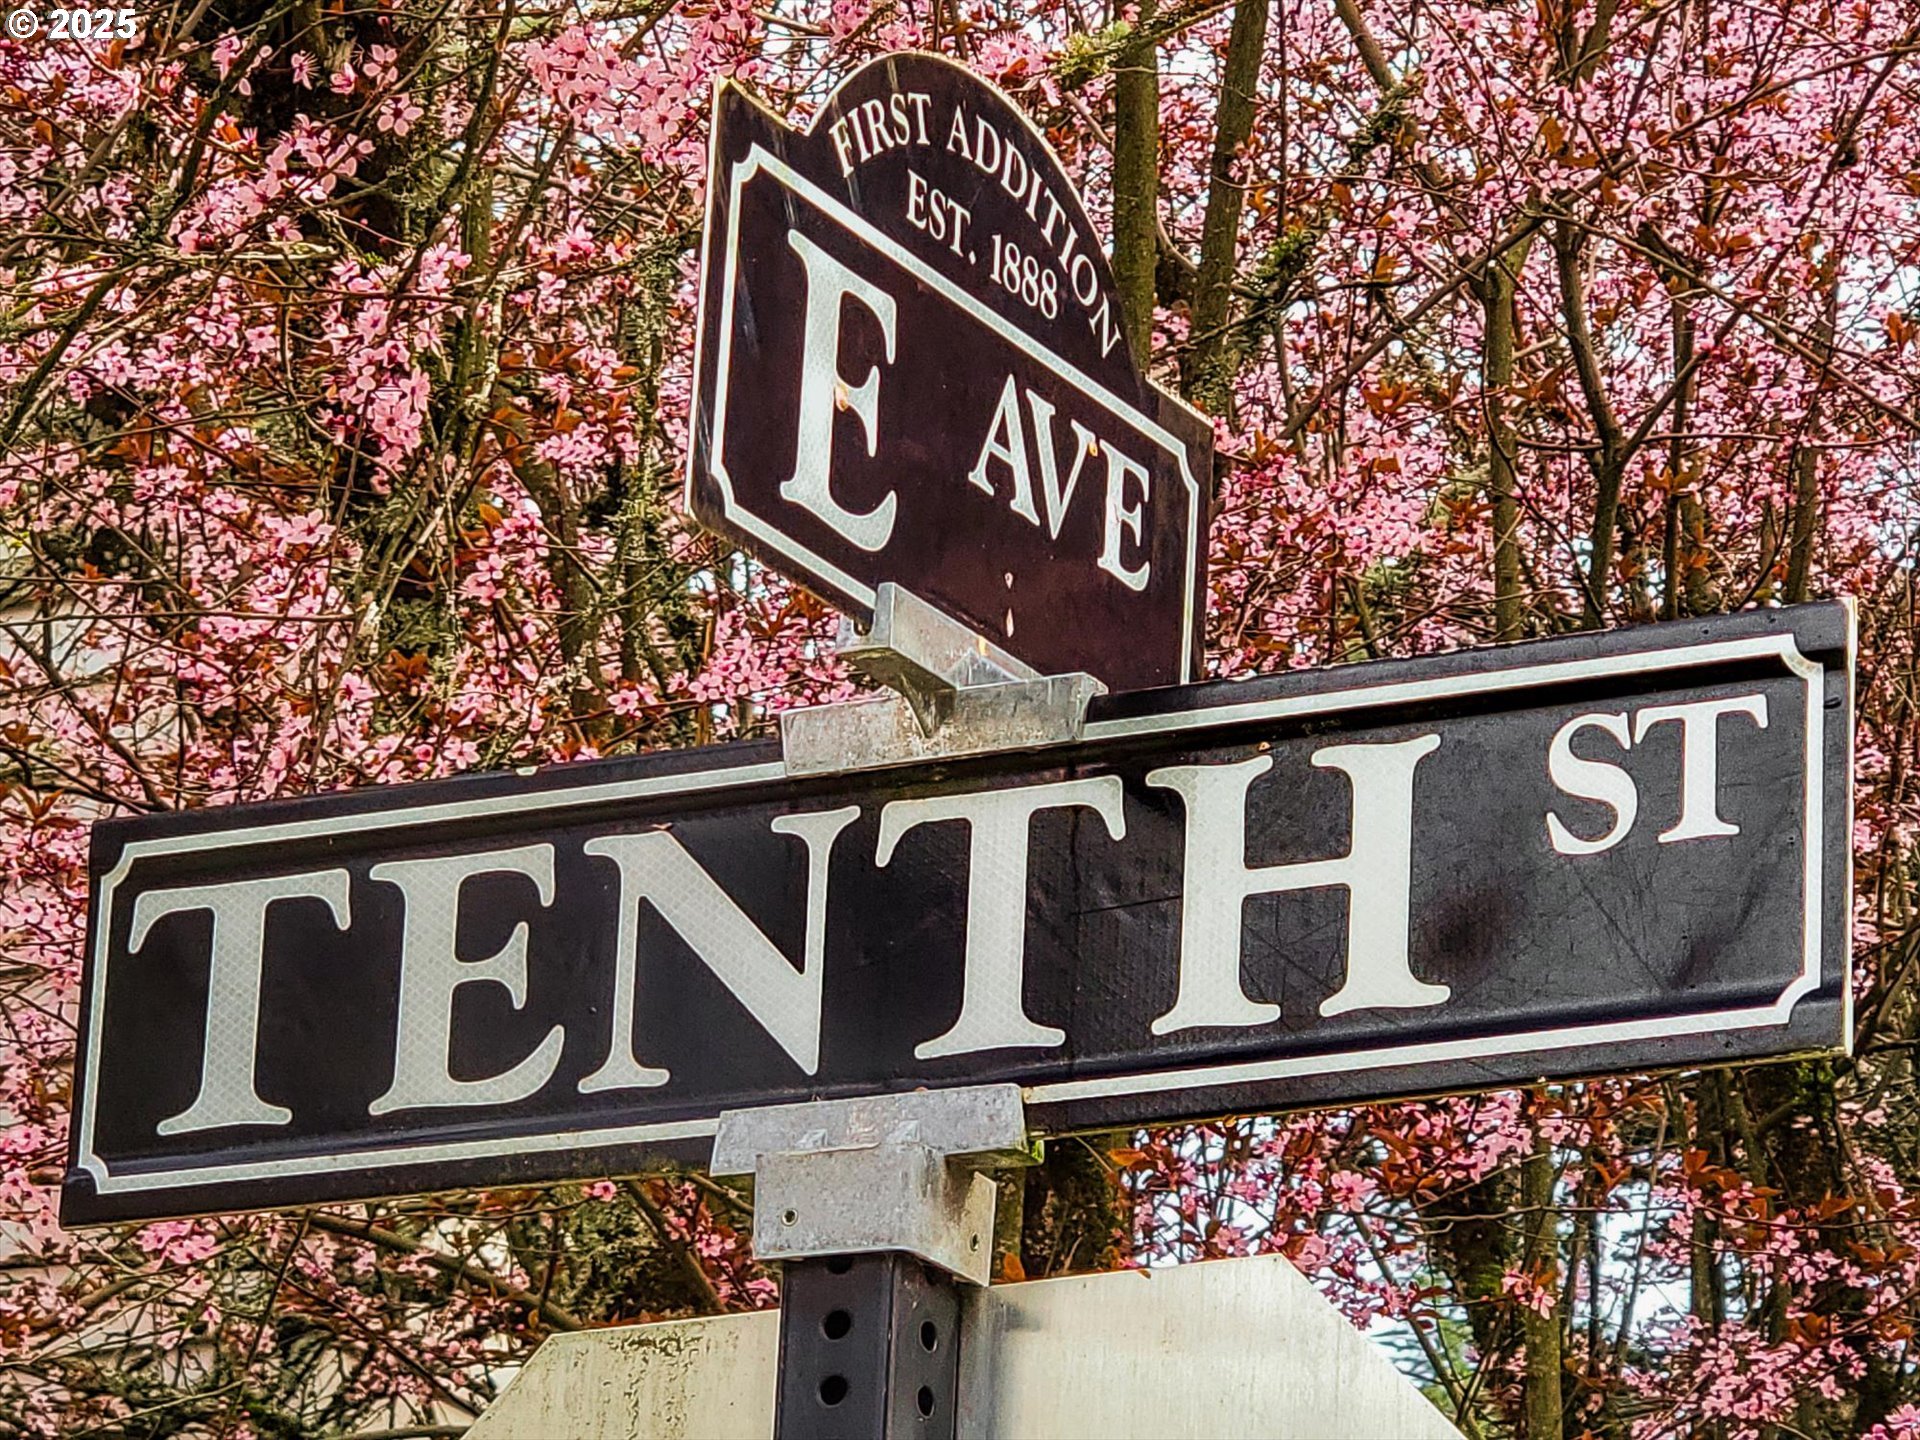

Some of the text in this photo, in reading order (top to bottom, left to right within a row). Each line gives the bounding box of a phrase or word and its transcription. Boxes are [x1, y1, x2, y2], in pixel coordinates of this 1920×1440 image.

[828, 91, 1122, 359] FIRST ADDITION
[905, 168, 1058, 321] EST. 1888
[780, 228, 1151, 592] E AVE
[129, 695, 1771, 1136] TENTH ST
